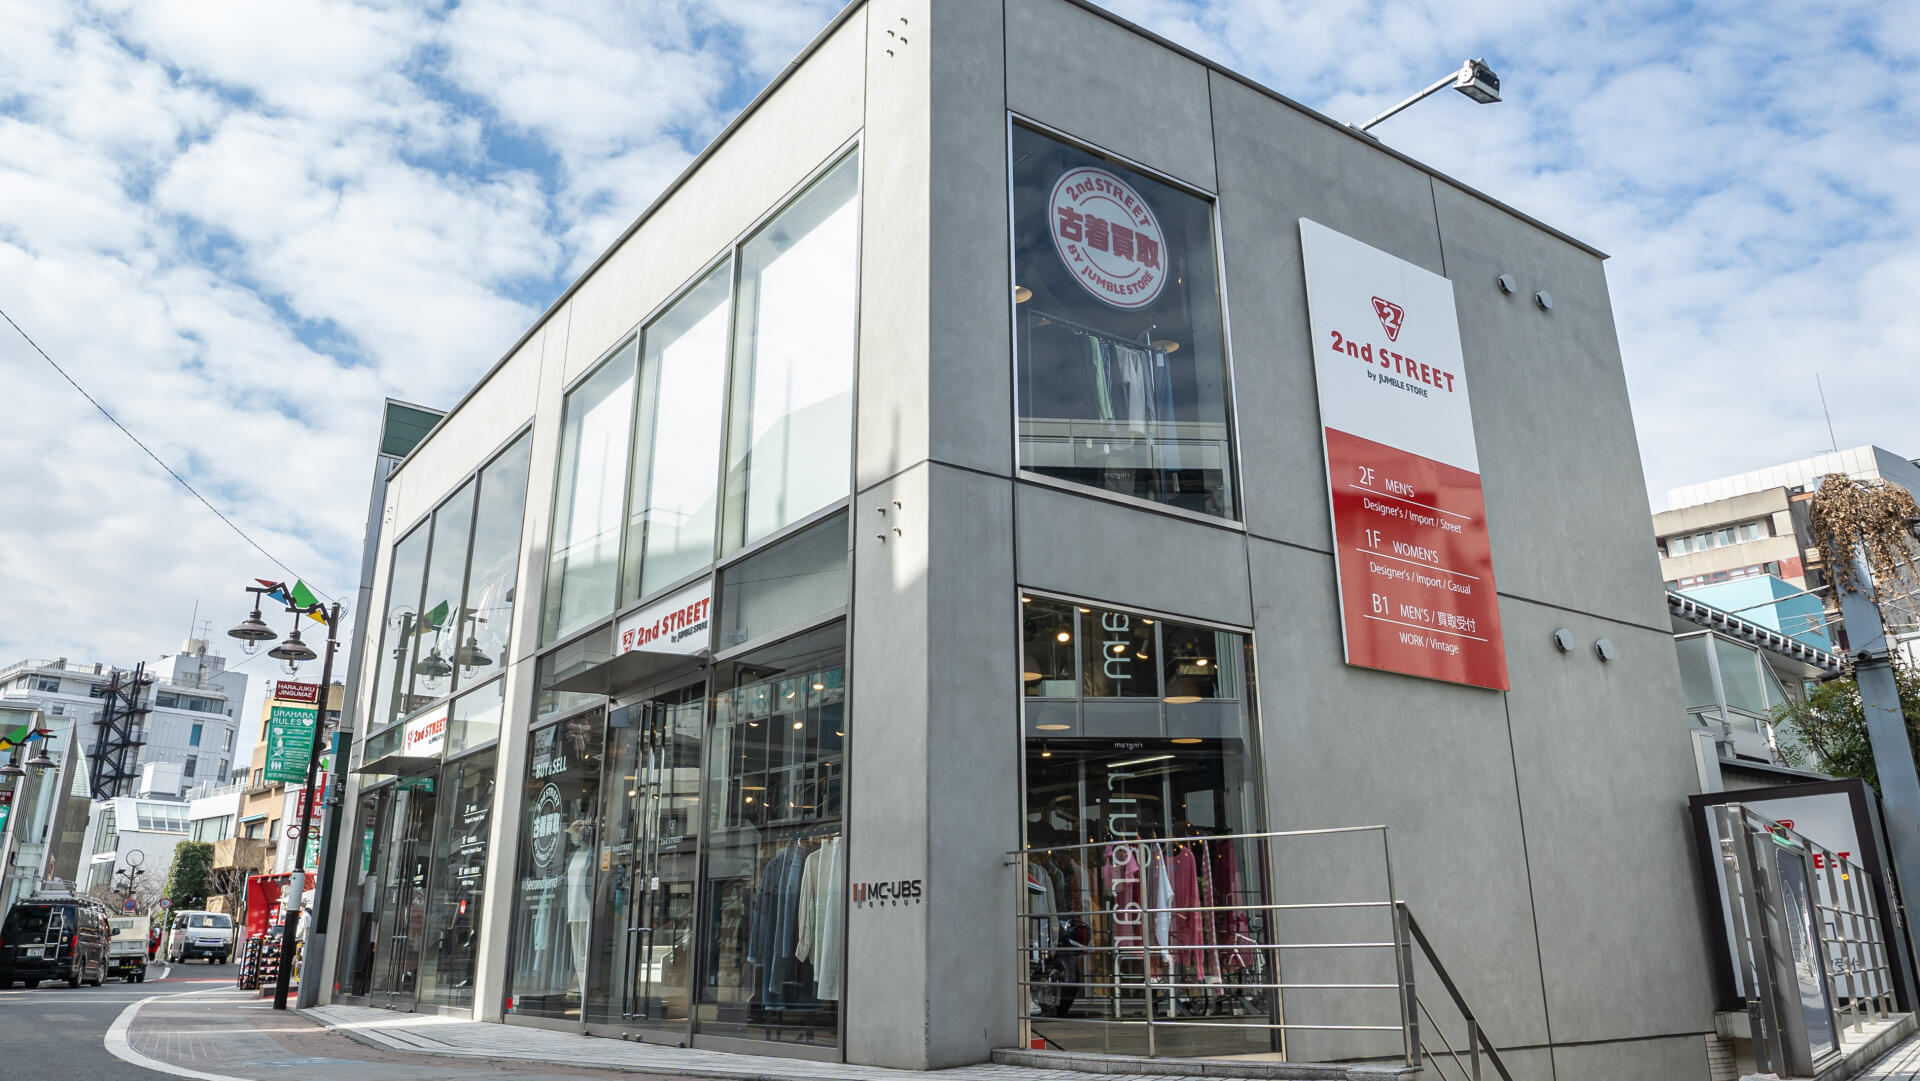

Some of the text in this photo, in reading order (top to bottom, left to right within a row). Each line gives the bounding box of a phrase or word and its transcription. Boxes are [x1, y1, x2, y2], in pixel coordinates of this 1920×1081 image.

[1065, 177, 1152, 228] 2nd STREET
[1057, 206, 1161, 272] 古着買取
[1067, 244, 1154, 295] BY JUMBLE STORE
[1331, 330, 1455, 393] 2nd STREET
[1367, 369, 1428, 398] by JUMBLE STORE
[1359, 466, 1415, 498] 2F MEN'S
[1363, 497, 1404, 518] Designer's
[1409, 510, 1435, 526] Import
[1440, 518, 1463, 534] Street
[1365, 529, 1439, 563] 1F WOMEN'S
[1369, 561, 1411, 581] Designer's
[1416, 572, 1442, 588] Import
[1447, 580, 1471, 595] Casual
[637, 620, 660, 647] 2nd
[661, 597, 710, 635] STREET
[1372, 593, 1389, 615] B1
[1400, 603, 1430, 623] MEN'S
[1399, 632, 1425, 648] WORK
[1429, 638, 1460, 656] Vintage
[278, 683, 315, 692] HARAJUKU
[278, 690, 313, 698] JINGUMAE
[272, 718, 302, 726] RULES
[273, 710, 314, 719] URAHARA
[425, 717, 447, 738] STREET
